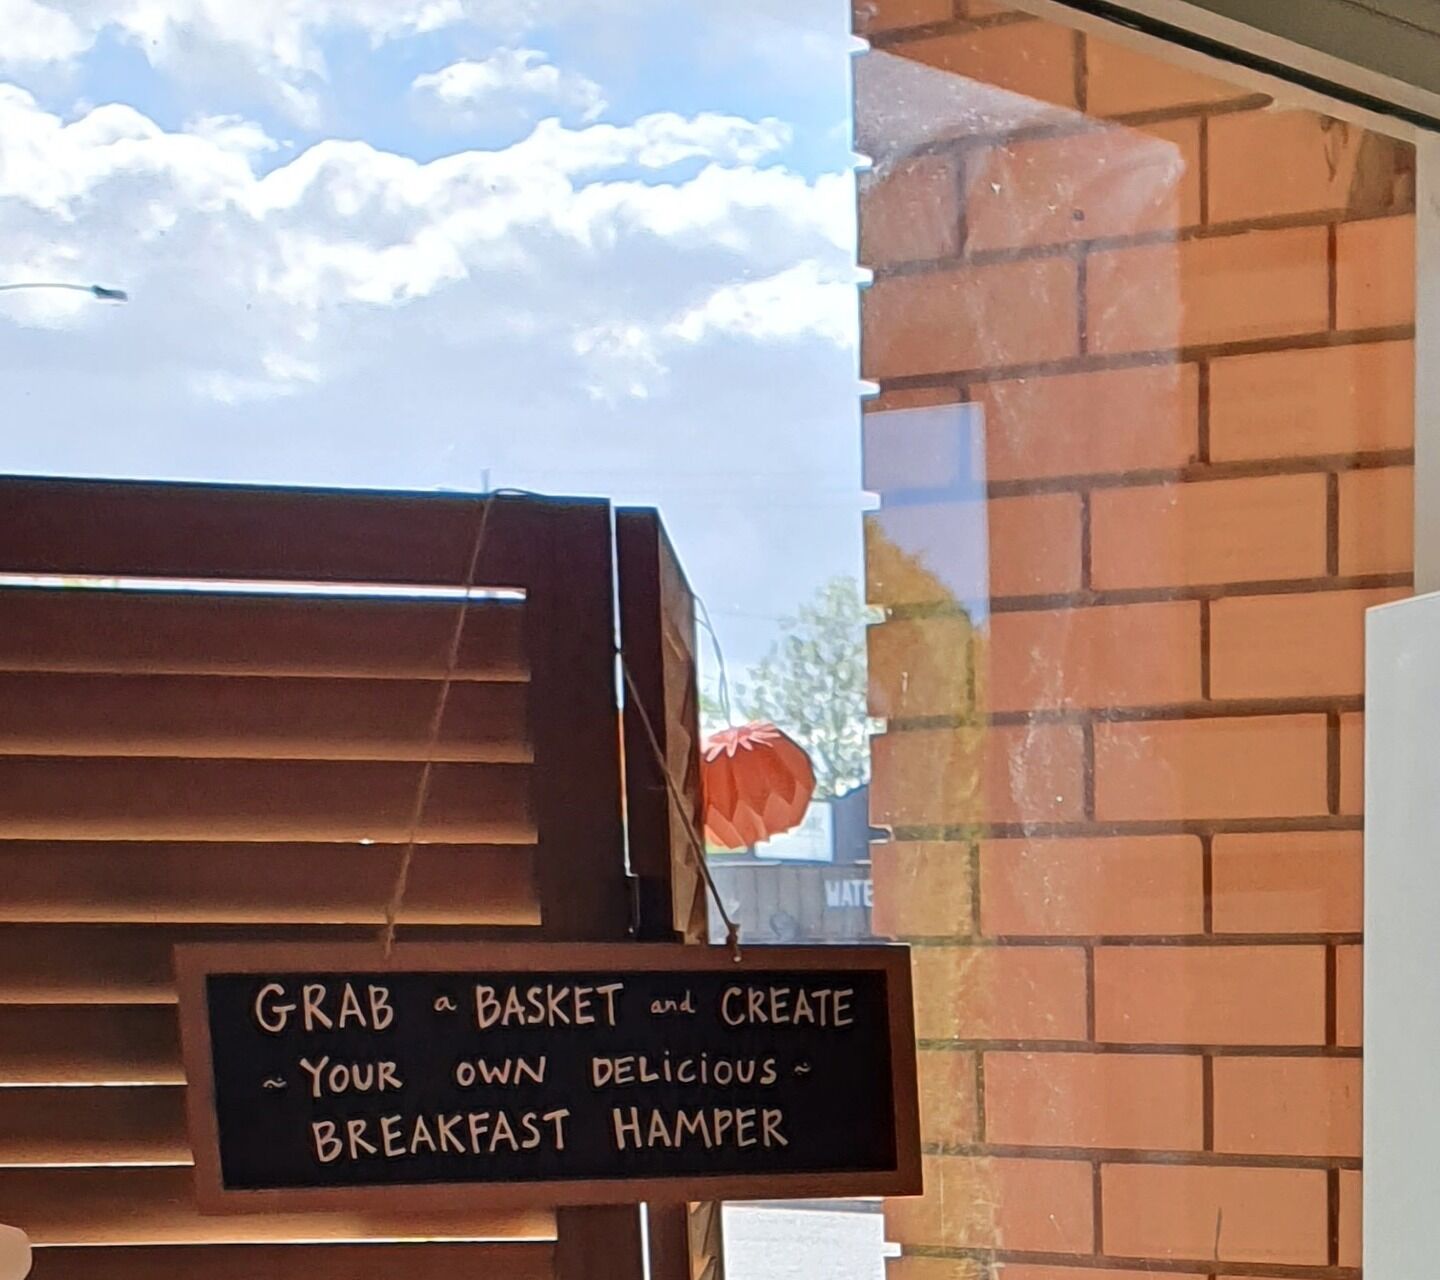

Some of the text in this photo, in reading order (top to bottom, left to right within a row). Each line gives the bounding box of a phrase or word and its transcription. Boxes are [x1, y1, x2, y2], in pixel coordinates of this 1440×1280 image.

[256, 982, 856, 1033] GRAB a BASKET and CREATE
[299, 1055, 404, 1098] YOUR
[456, 1055, 546, 1087] OWN
[312, 1106, 789, 1164] BREAKFAST HAMPER
